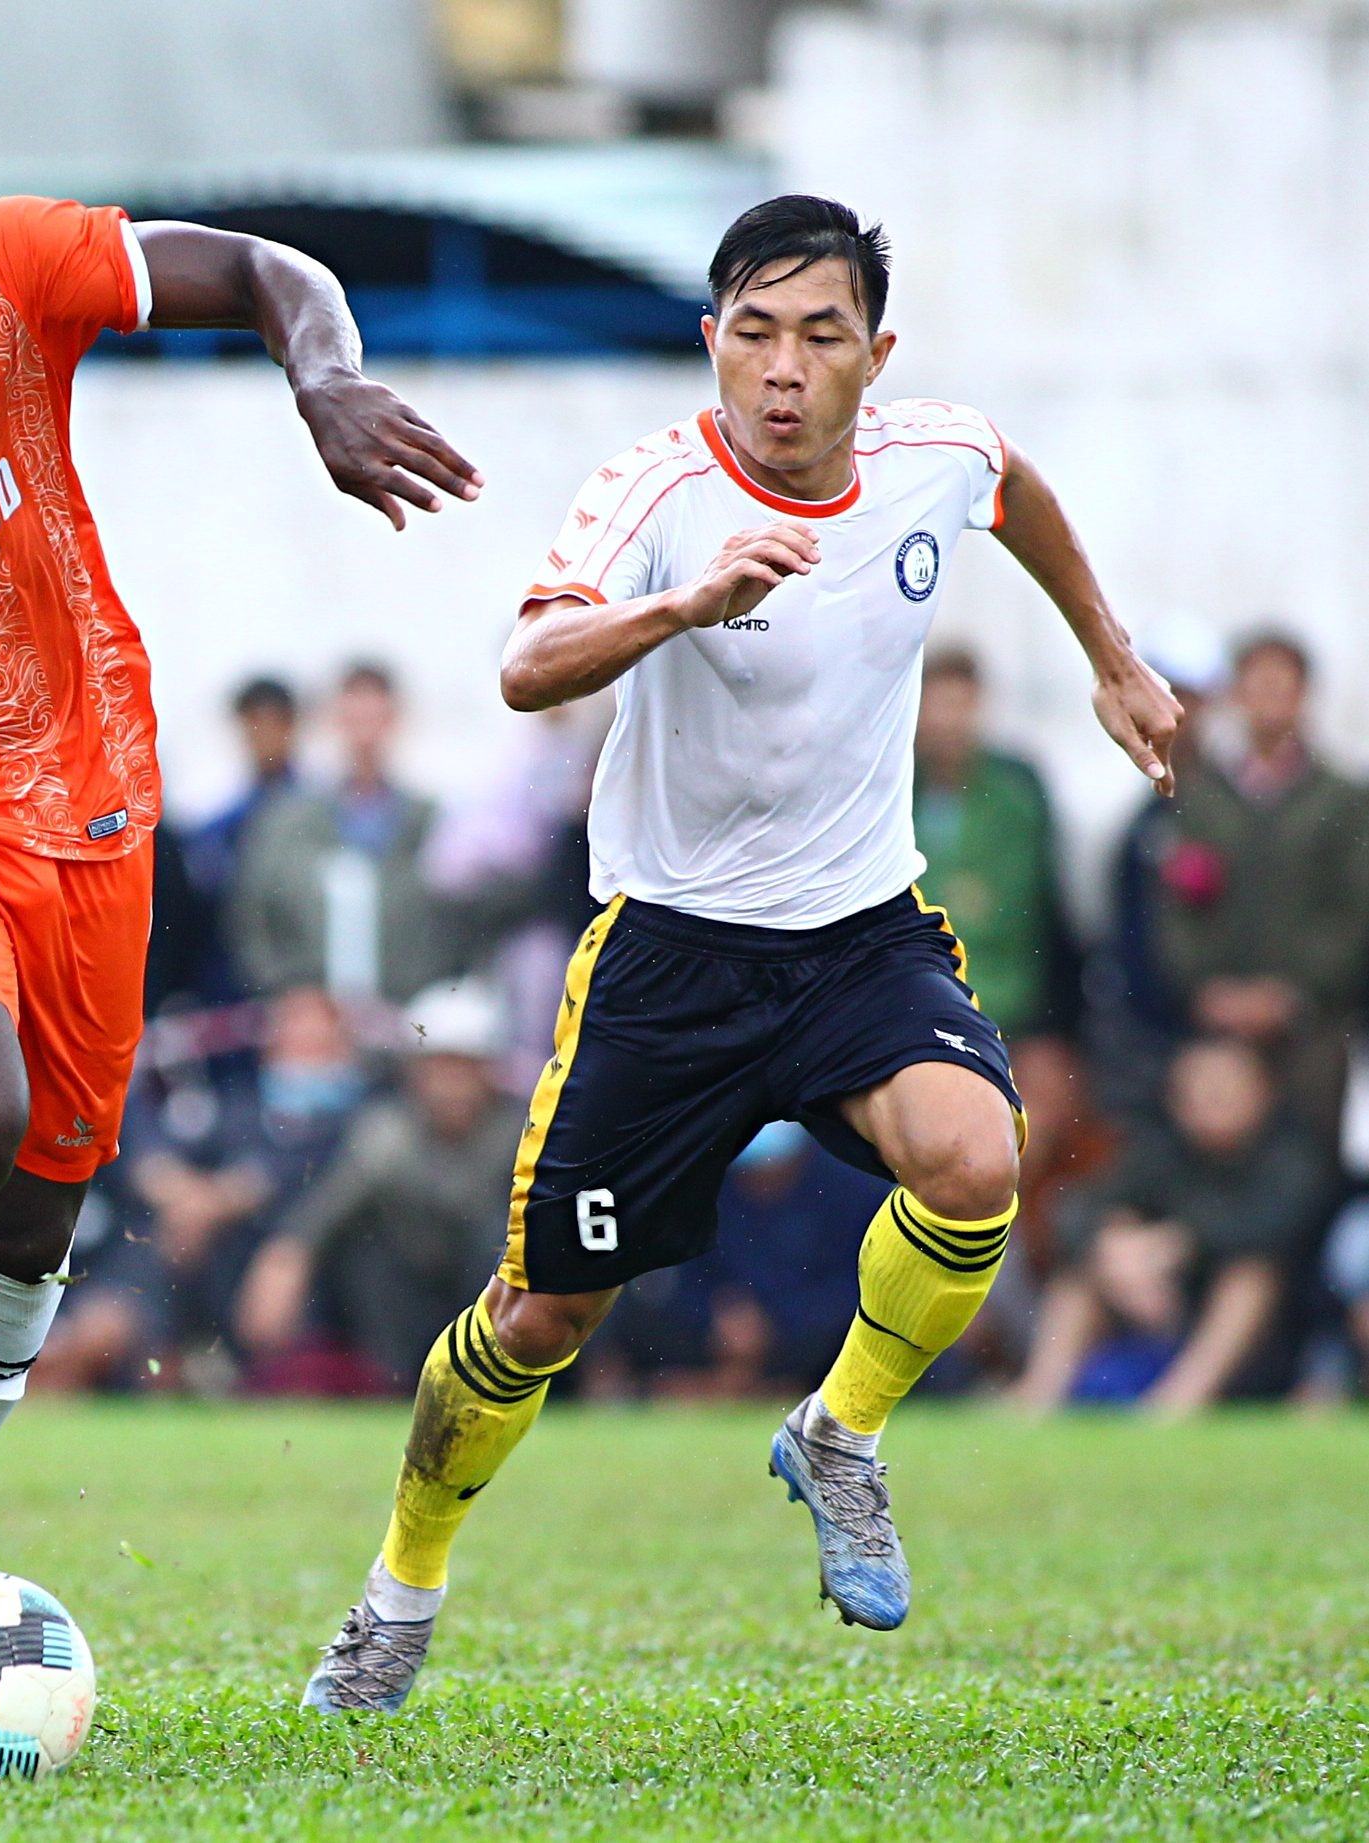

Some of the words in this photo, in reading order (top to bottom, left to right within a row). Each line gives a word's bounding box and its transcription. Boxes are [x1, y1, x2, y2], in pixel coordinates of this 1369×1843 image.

[897, 534, 920, 562] KHANH
[723, 619, 769, 632] KAMITO
[576, 1188, 618, 1252] 6
